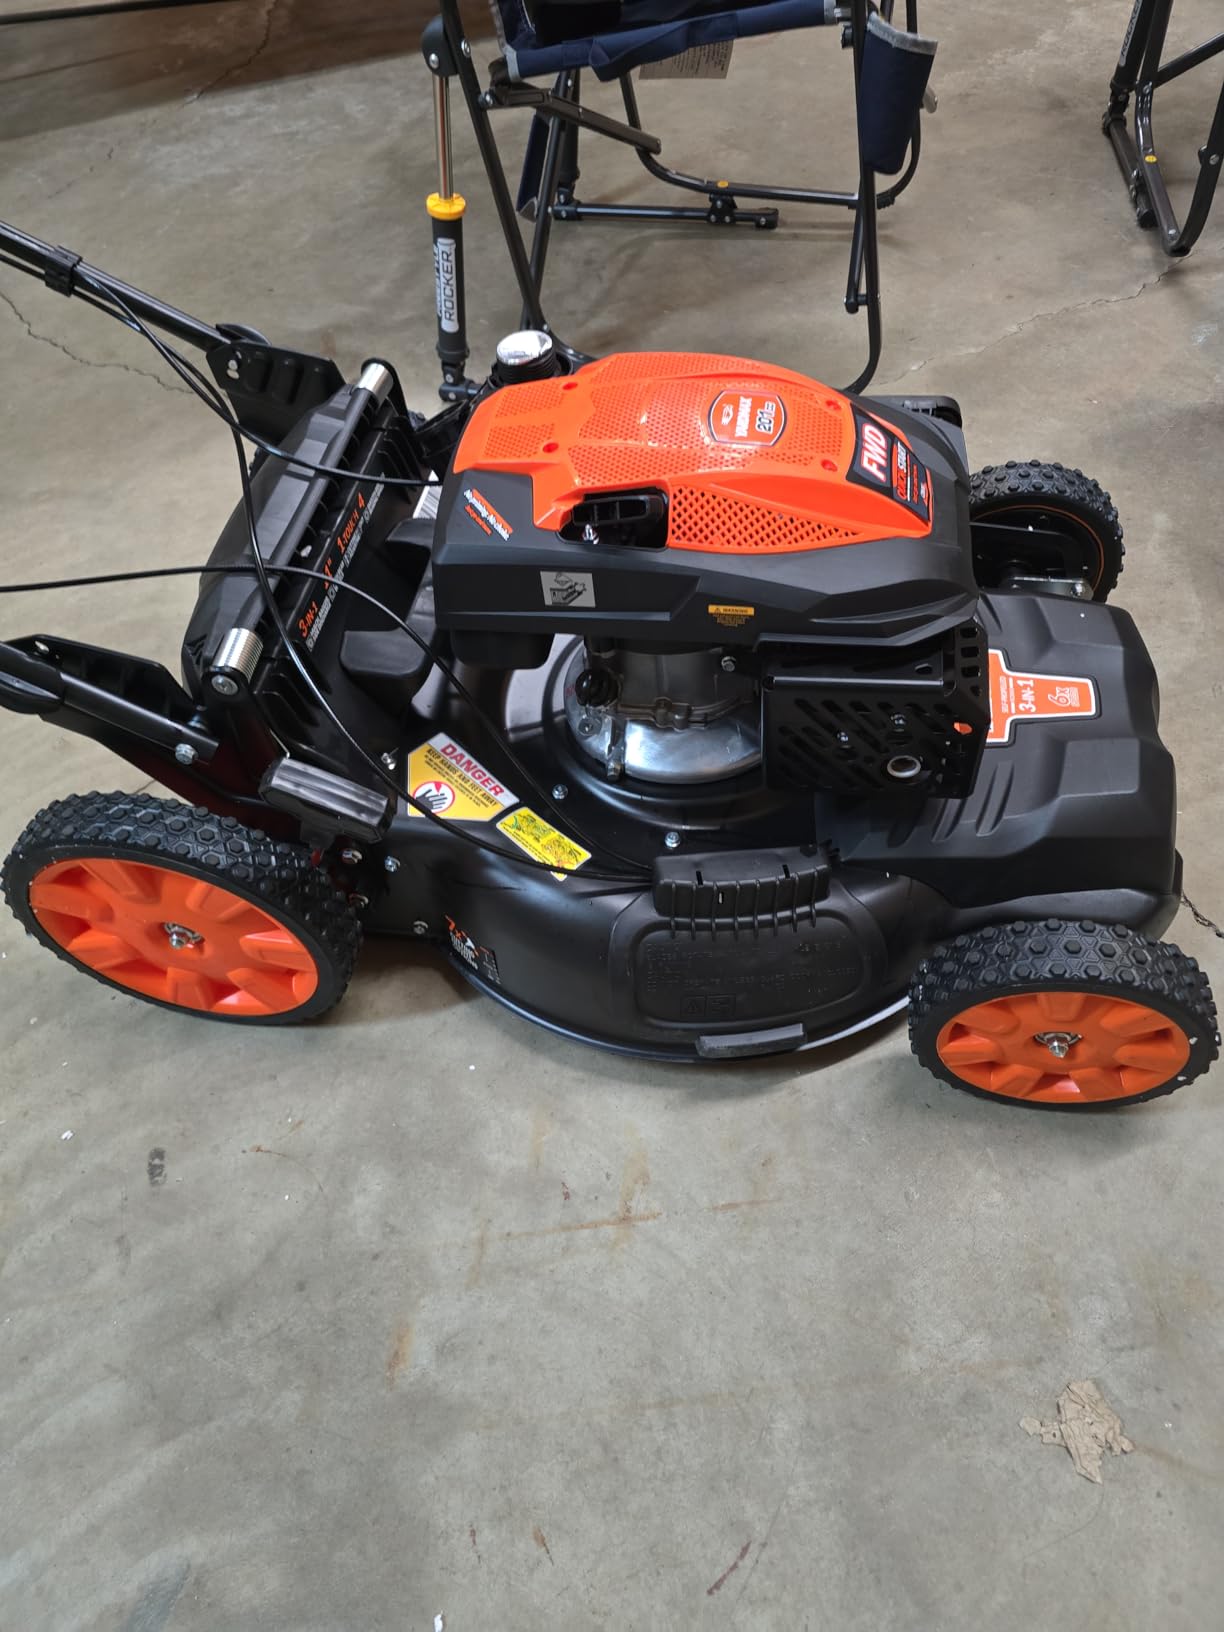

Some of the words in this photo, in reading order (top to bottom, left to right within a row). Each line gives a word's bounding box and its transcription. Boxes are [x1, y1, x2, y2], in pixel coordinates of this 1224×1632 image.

[441, 250, 455, 322] ROCKER
[861, 423, 887, 482] FWD
[1016, 679, 1036, 713] 3-IN-1
[440, 743, 505, 796] DANGER
